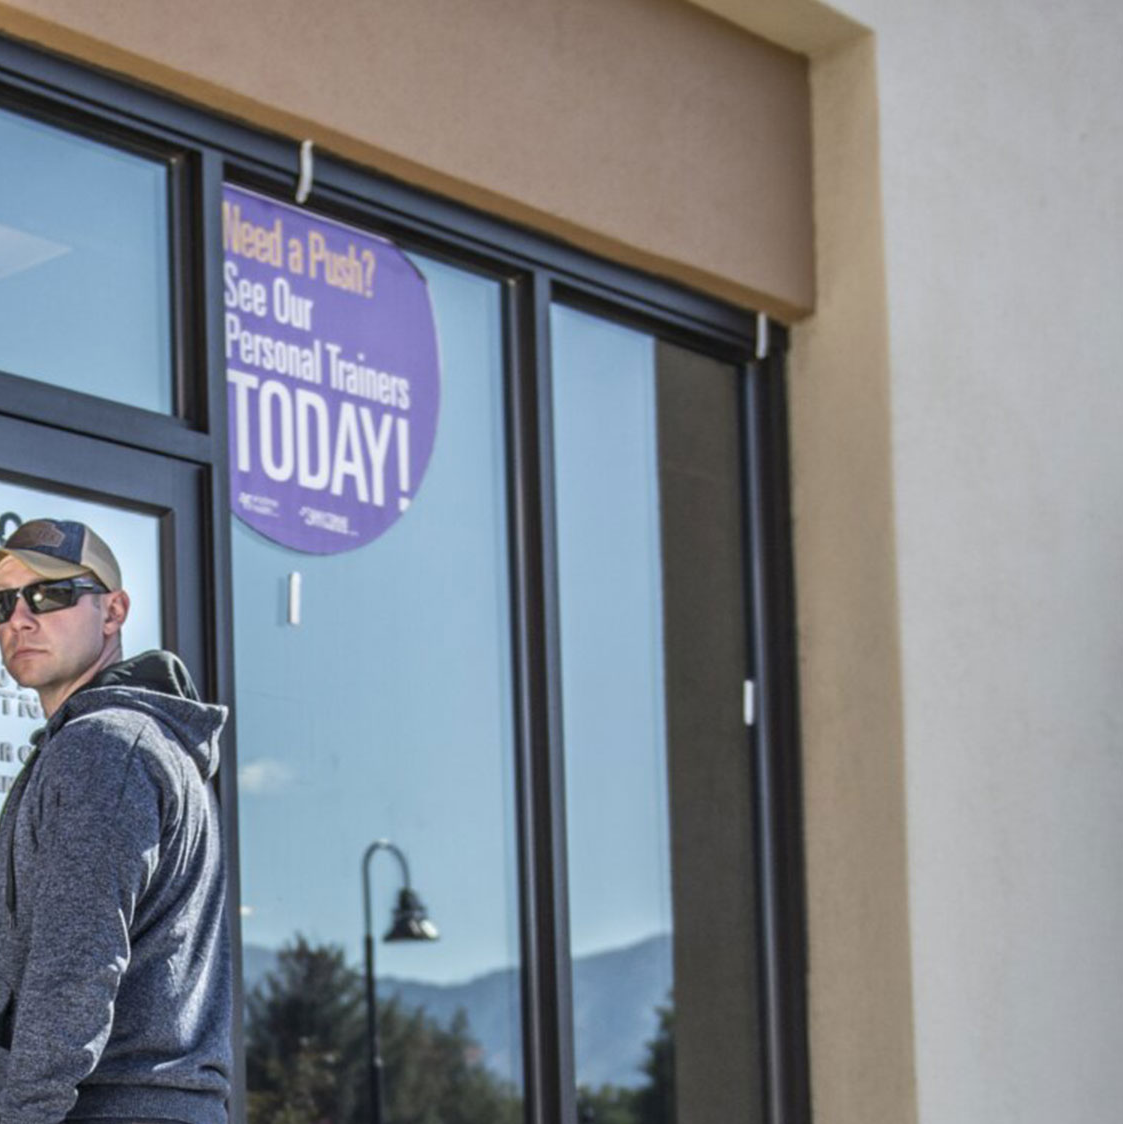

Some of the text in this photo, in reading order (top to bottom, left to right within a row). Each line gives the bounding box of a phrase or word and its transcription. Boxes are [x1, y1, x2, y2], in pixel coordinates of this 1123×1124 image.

[222, 201, 376, 298] Need a Push?
[223, 260, 314, 331] See Our
[225, 312, 411, 411] Personal Trainers
[227, 368, 411, 513] TODAY!
